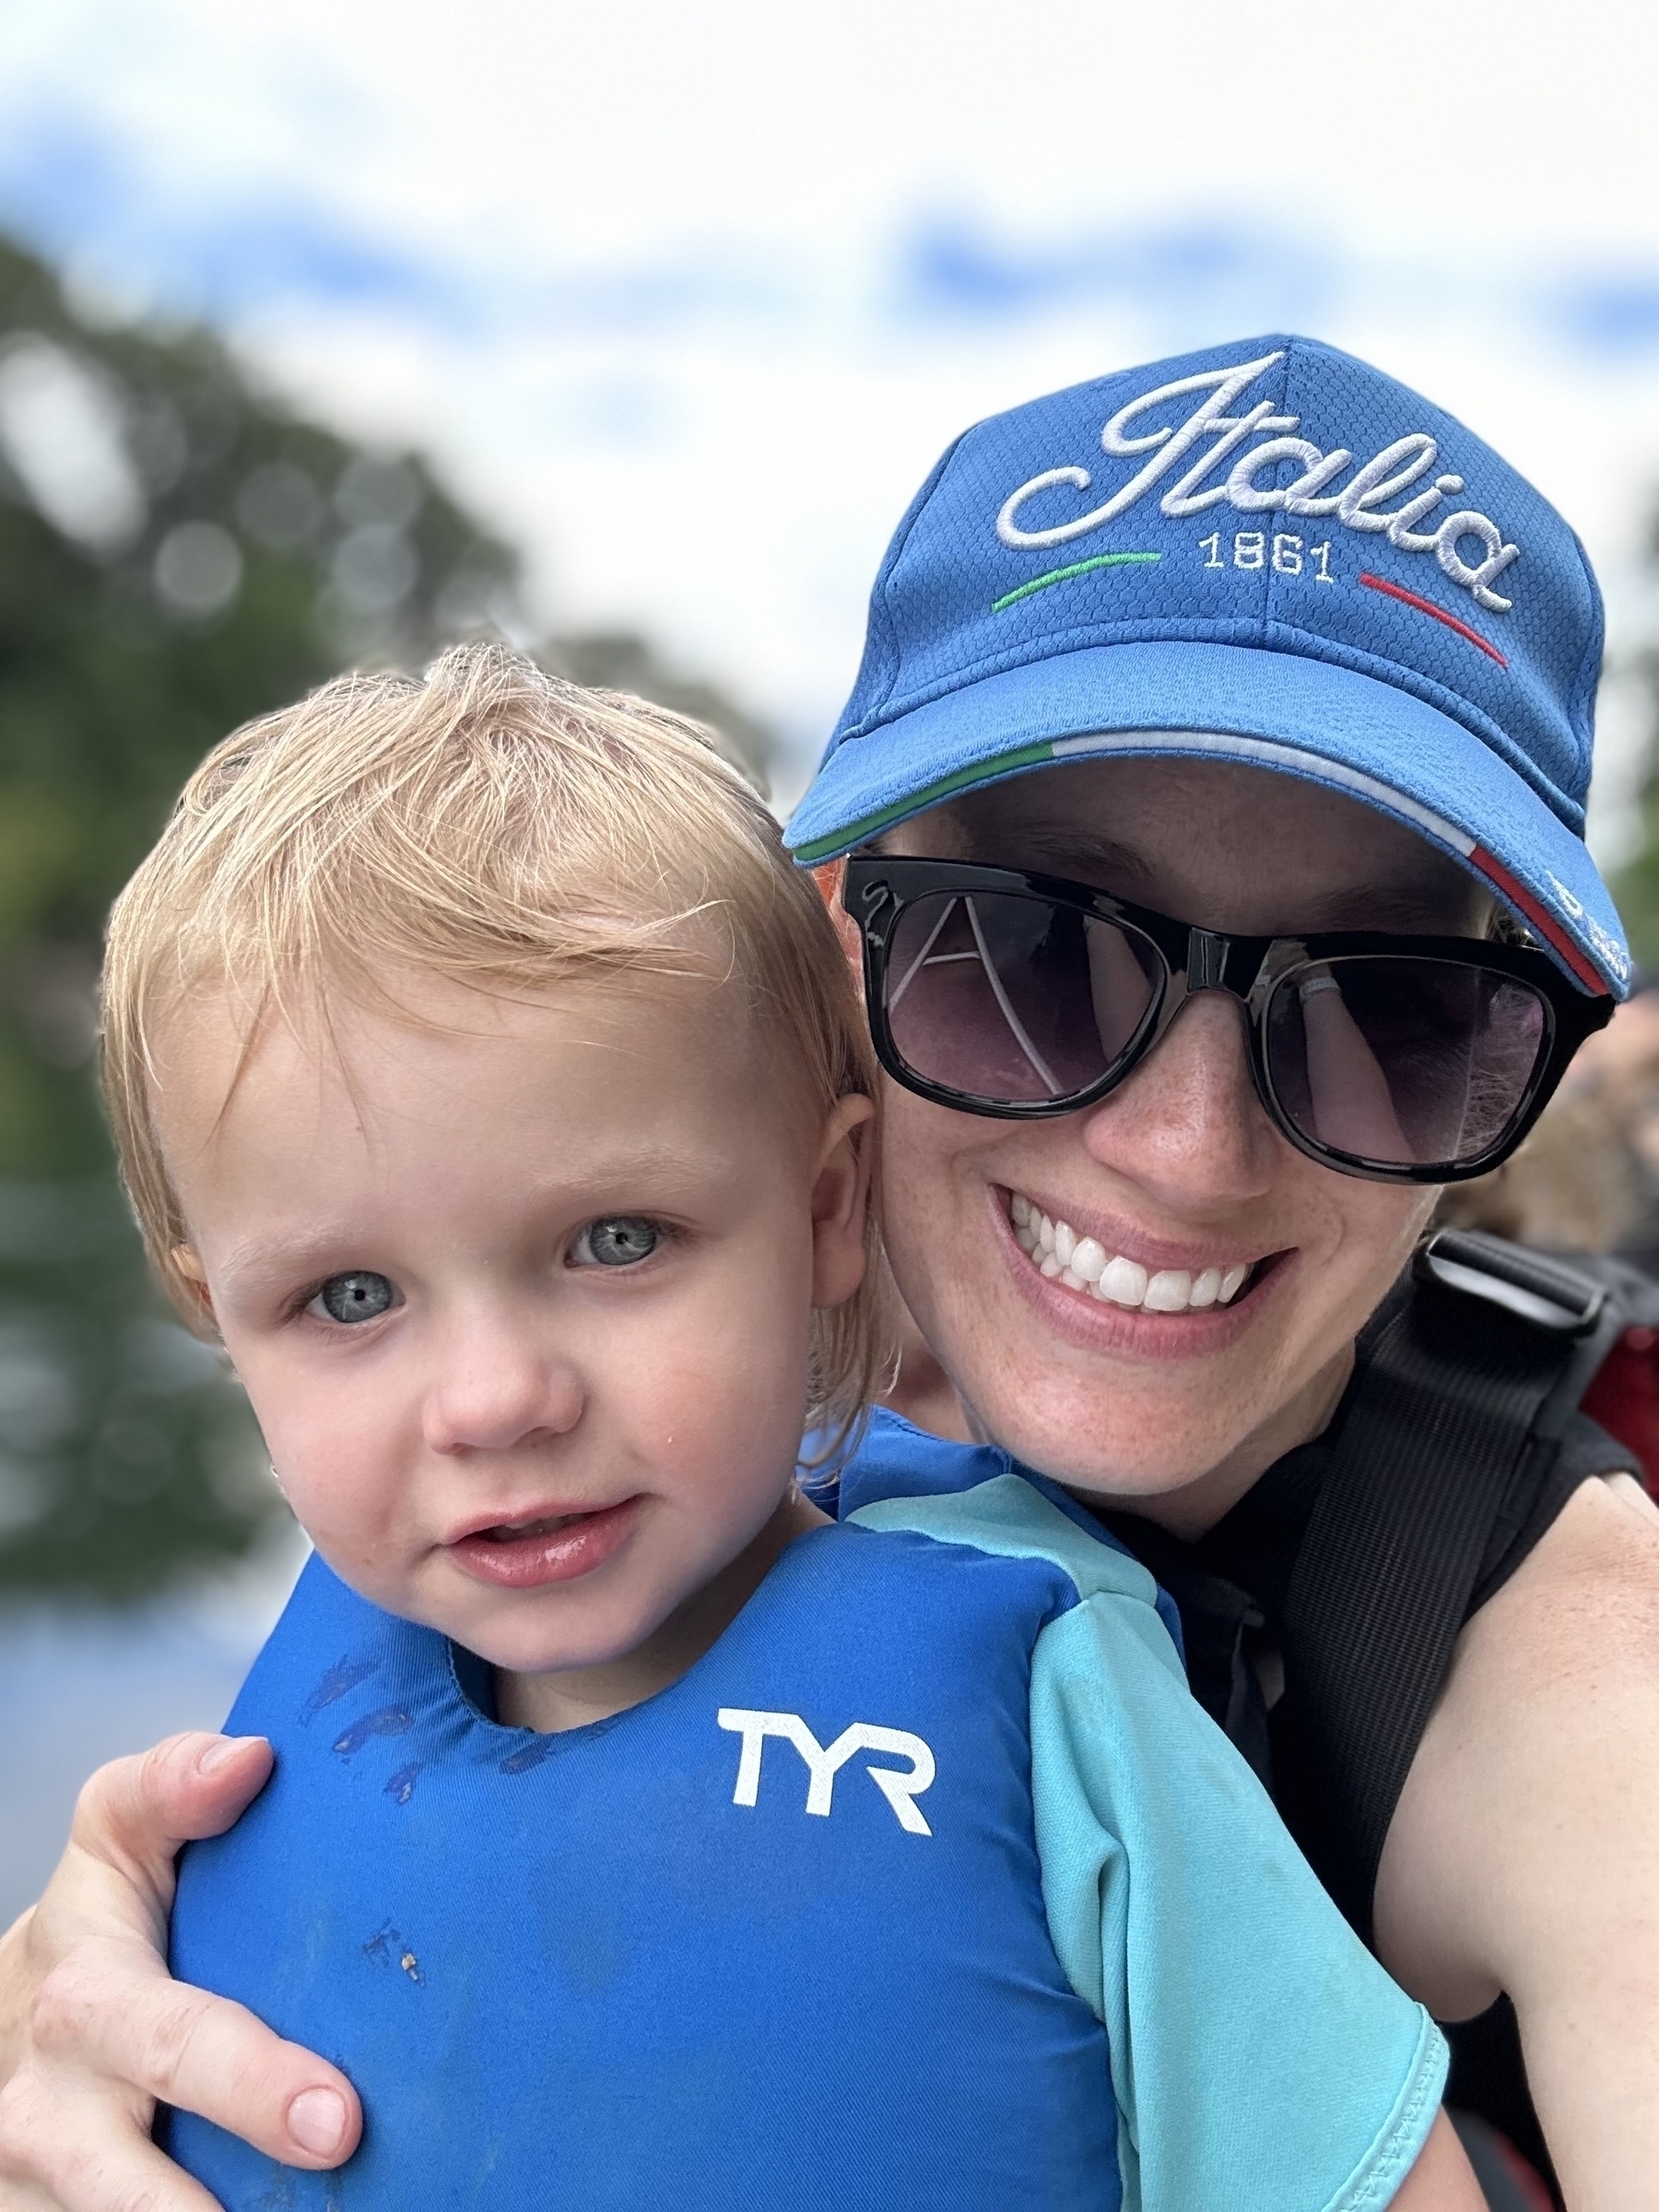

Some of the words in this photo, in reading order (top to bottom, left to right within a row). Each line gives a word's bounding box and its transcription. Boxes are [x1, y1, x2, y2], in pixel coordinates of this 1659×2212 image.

[996, 352, 1520, 611] Italia
[1198, 532, 1334, 582] 1861
[717, 1708, 935, 1836] TYR
